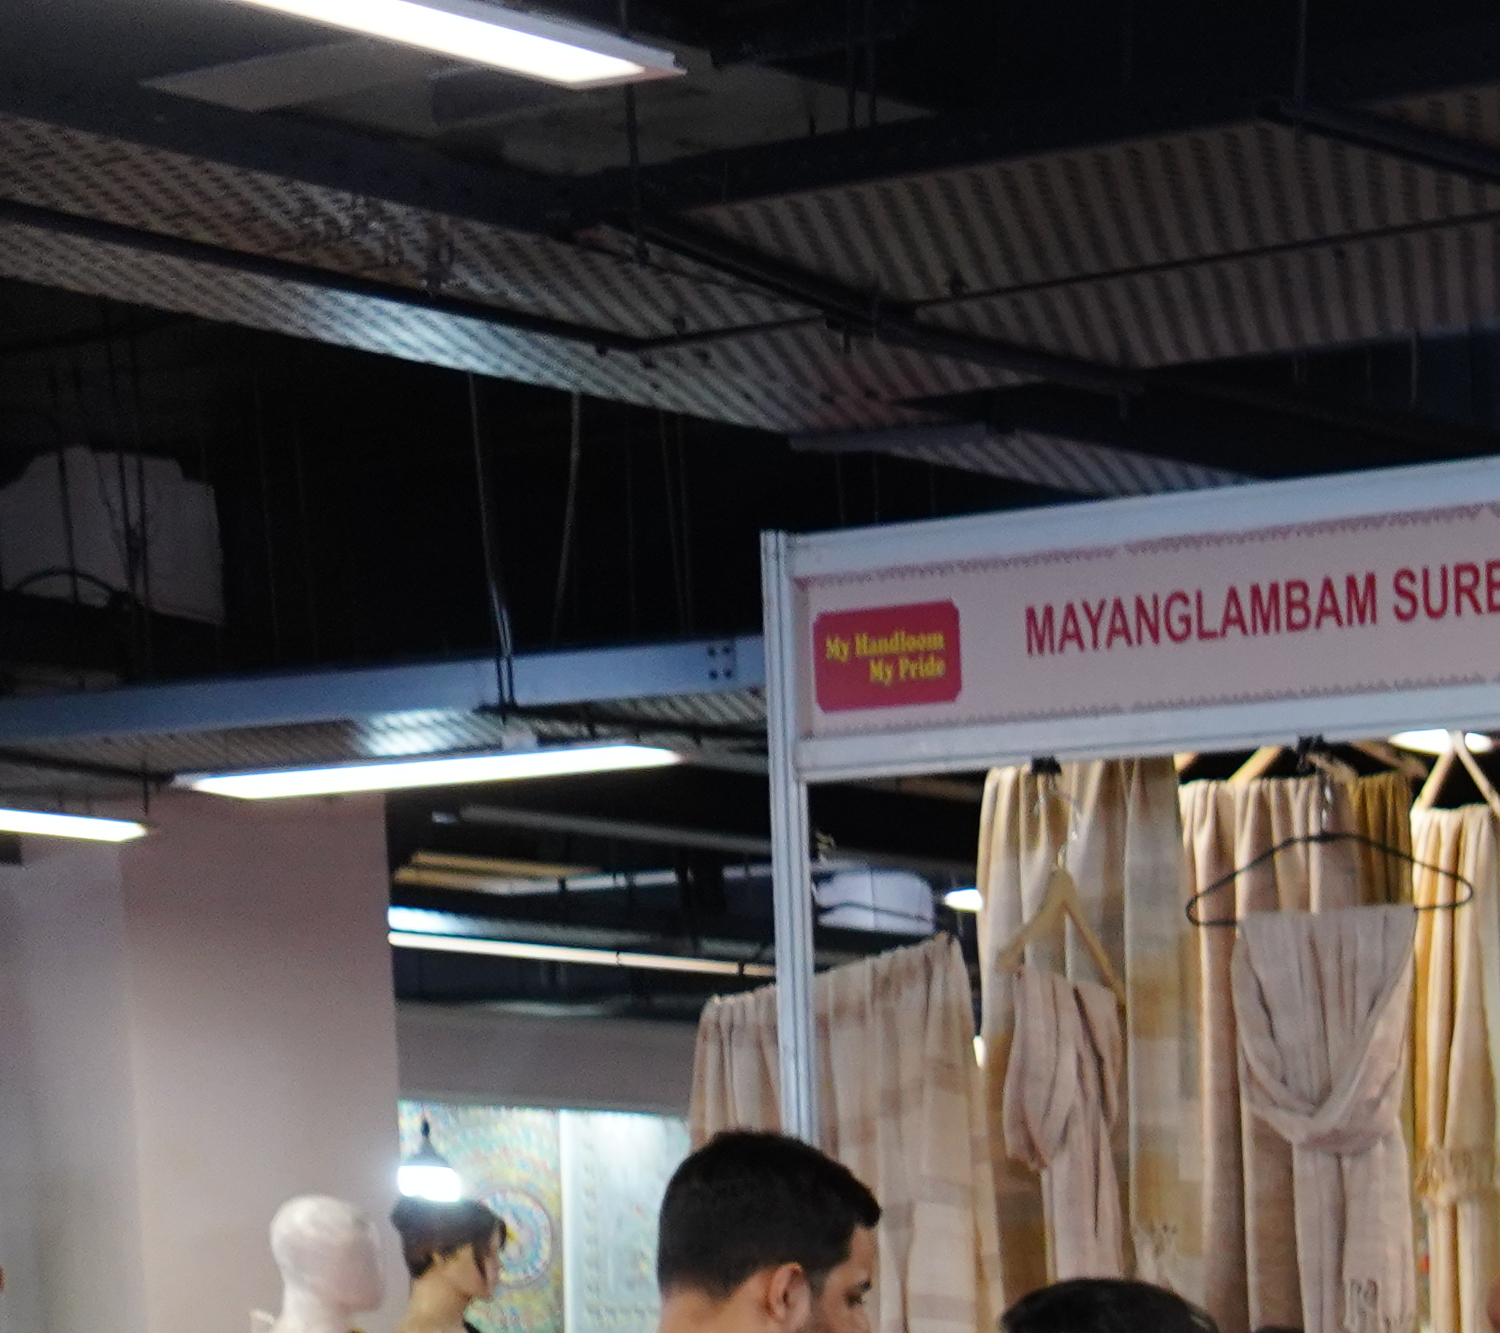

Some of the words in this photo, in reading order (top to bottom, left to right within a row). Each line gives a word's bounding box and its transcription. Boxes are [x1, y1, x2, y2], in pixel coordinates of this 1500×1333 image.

[1025, 571, 1377, 657] MAYANGLAMBAM
[826, 633, 849, 663] My
[855, 628, 945, 658] Handloom
[870, 659, 893, 686] My
[899, 654, 946, 681] Pride
